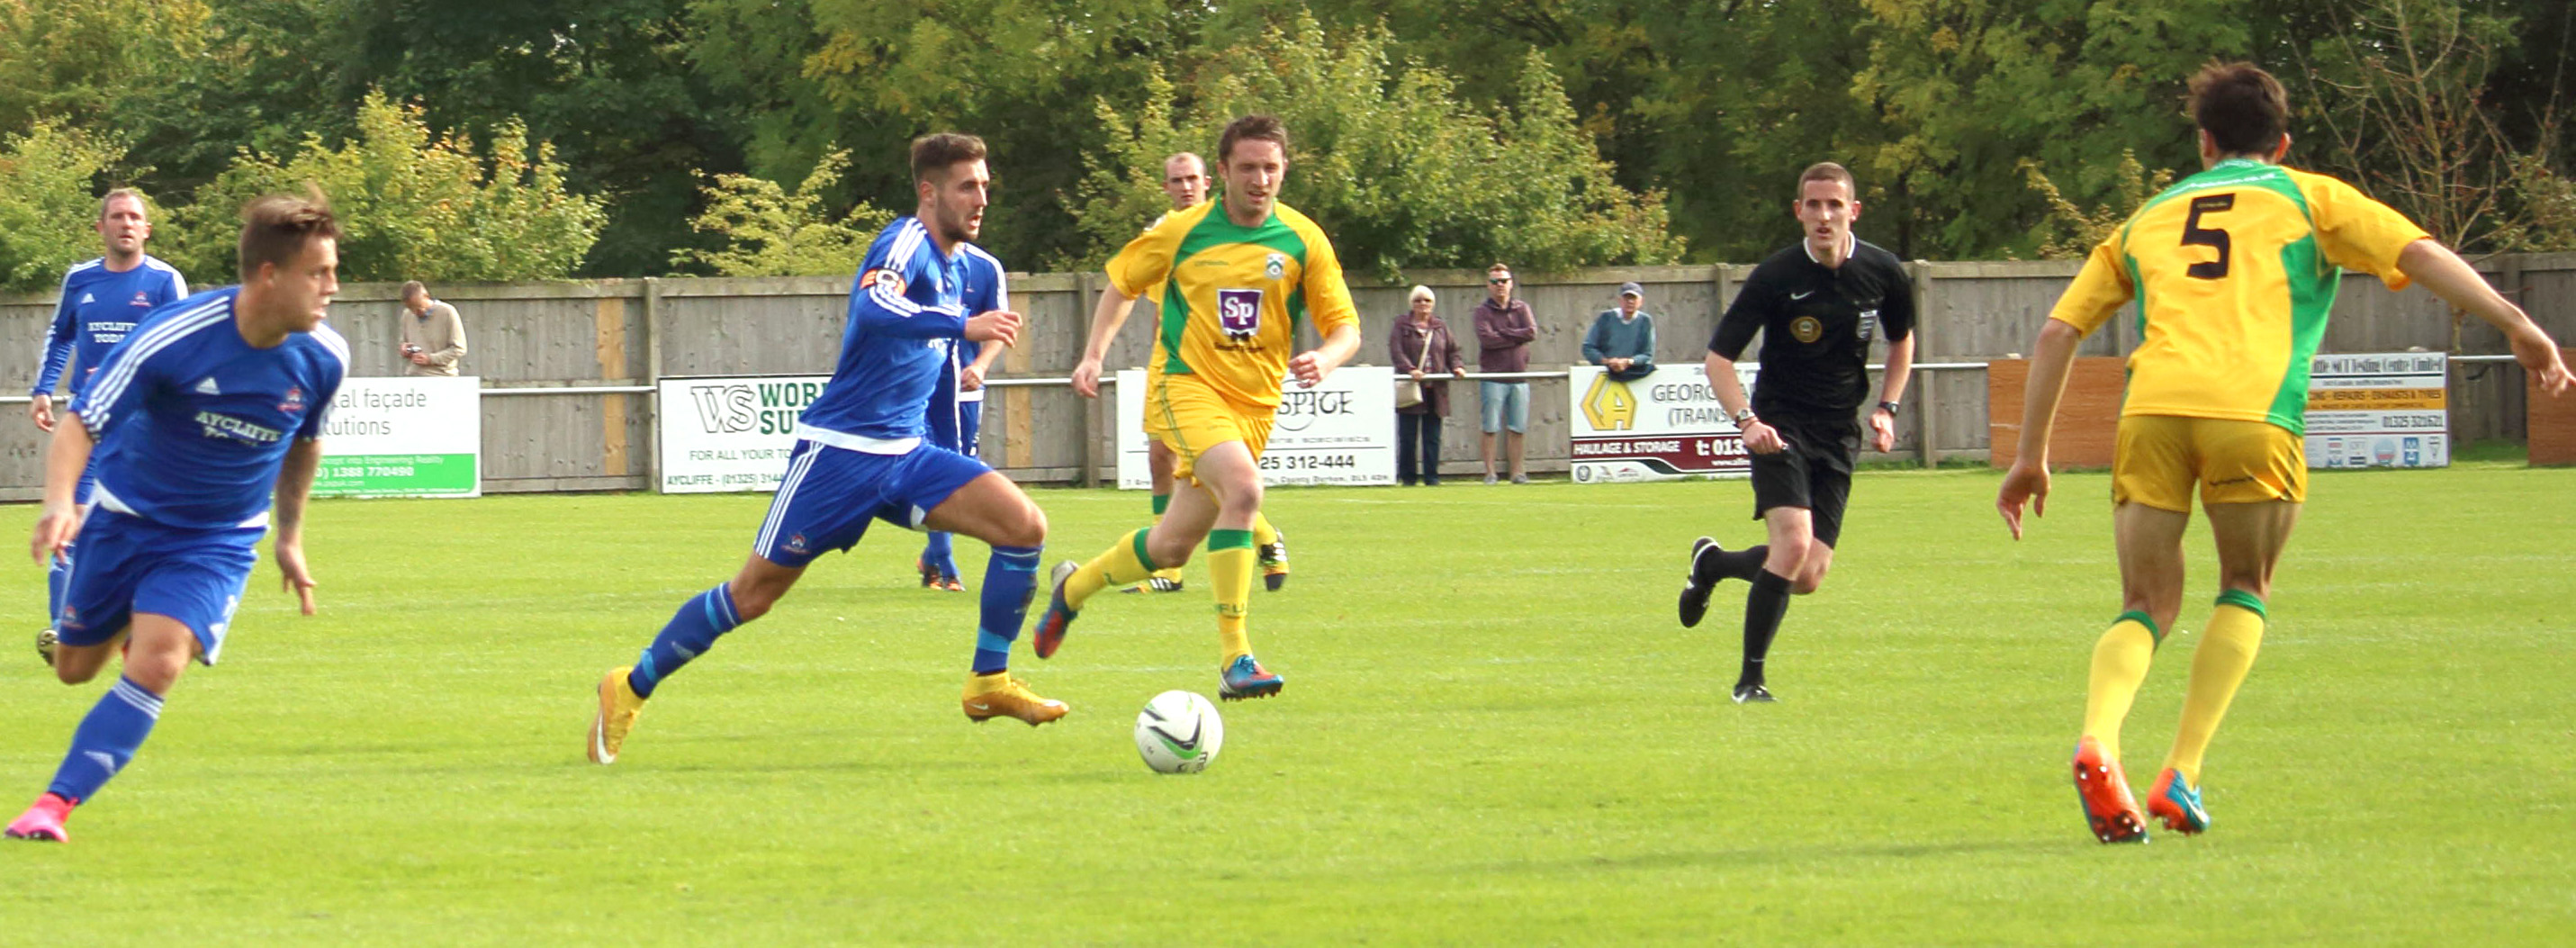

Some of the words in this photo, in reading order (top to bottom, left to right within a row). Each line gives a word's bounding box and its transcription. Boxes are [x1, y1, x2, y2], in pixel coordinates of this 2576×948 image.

[2180, 193, 2236, 280] 5
[1225, 296, 1255, 325] Sp
[364, 389, 427, 412] façade
[759, 383, 829, 407] WOR
[195, 411, 282, 442] AYCLIFFE
[760, 410, 804, 435] SU
[689, 451, 714, 460] FOR
[716, 451, 737, 460] ALL
[743, 450, 774, 460] YOUR
[1574, 443, 1622, 455] HAULAGE
[1624, 443, 1632, 453] &
[1634, 440, 1680, 452] STORAGE
[1696, 439, 1710, 456] t:
[364, 456, 414, 466] Engineering
[1260, 456, 1280, 470] 25
[1286, 455, 1355, 469] 312-444
[334, 467, 364, 477] 1388
[667, 475, 714, 485] AYCLIFFE
[723, 474, 758, 487] (01325)
